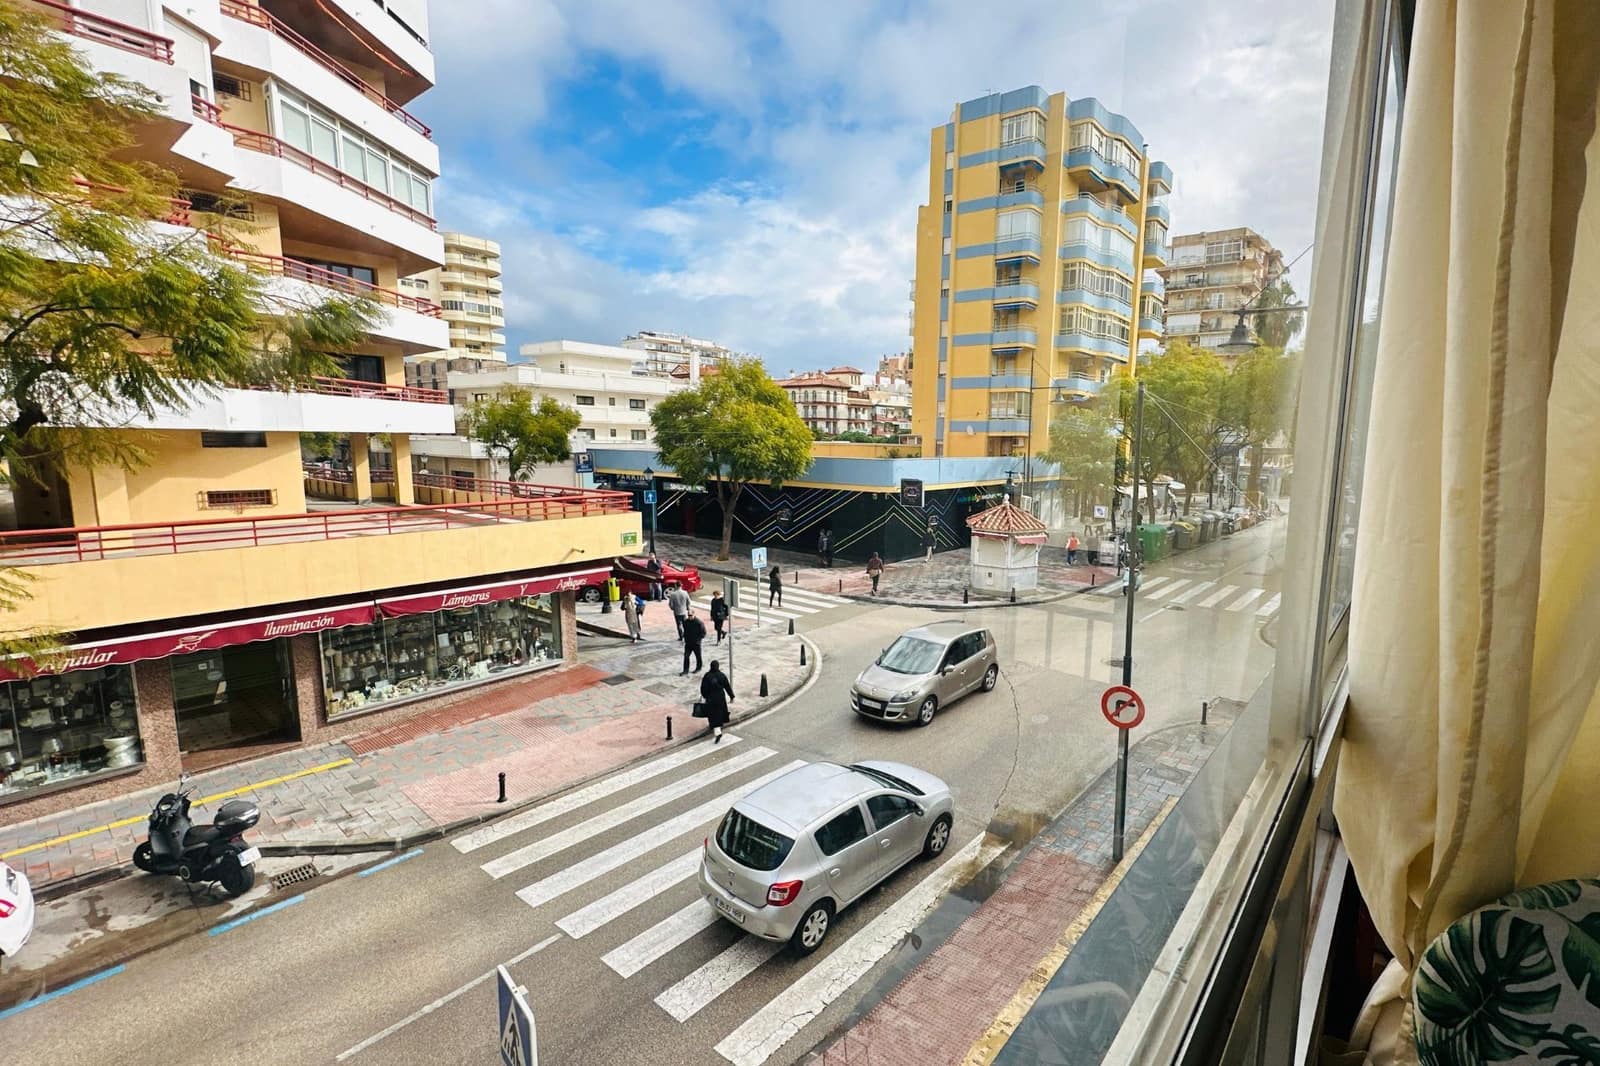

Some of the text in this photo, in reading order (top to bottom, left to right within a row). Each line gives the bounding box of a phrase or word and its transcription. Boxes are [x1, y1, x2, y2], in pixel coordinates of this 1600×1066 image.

[579, 454, 589, 465] P
[520, 584, 528, 596] Y
[263, 615, 335, 637] Iluminación
